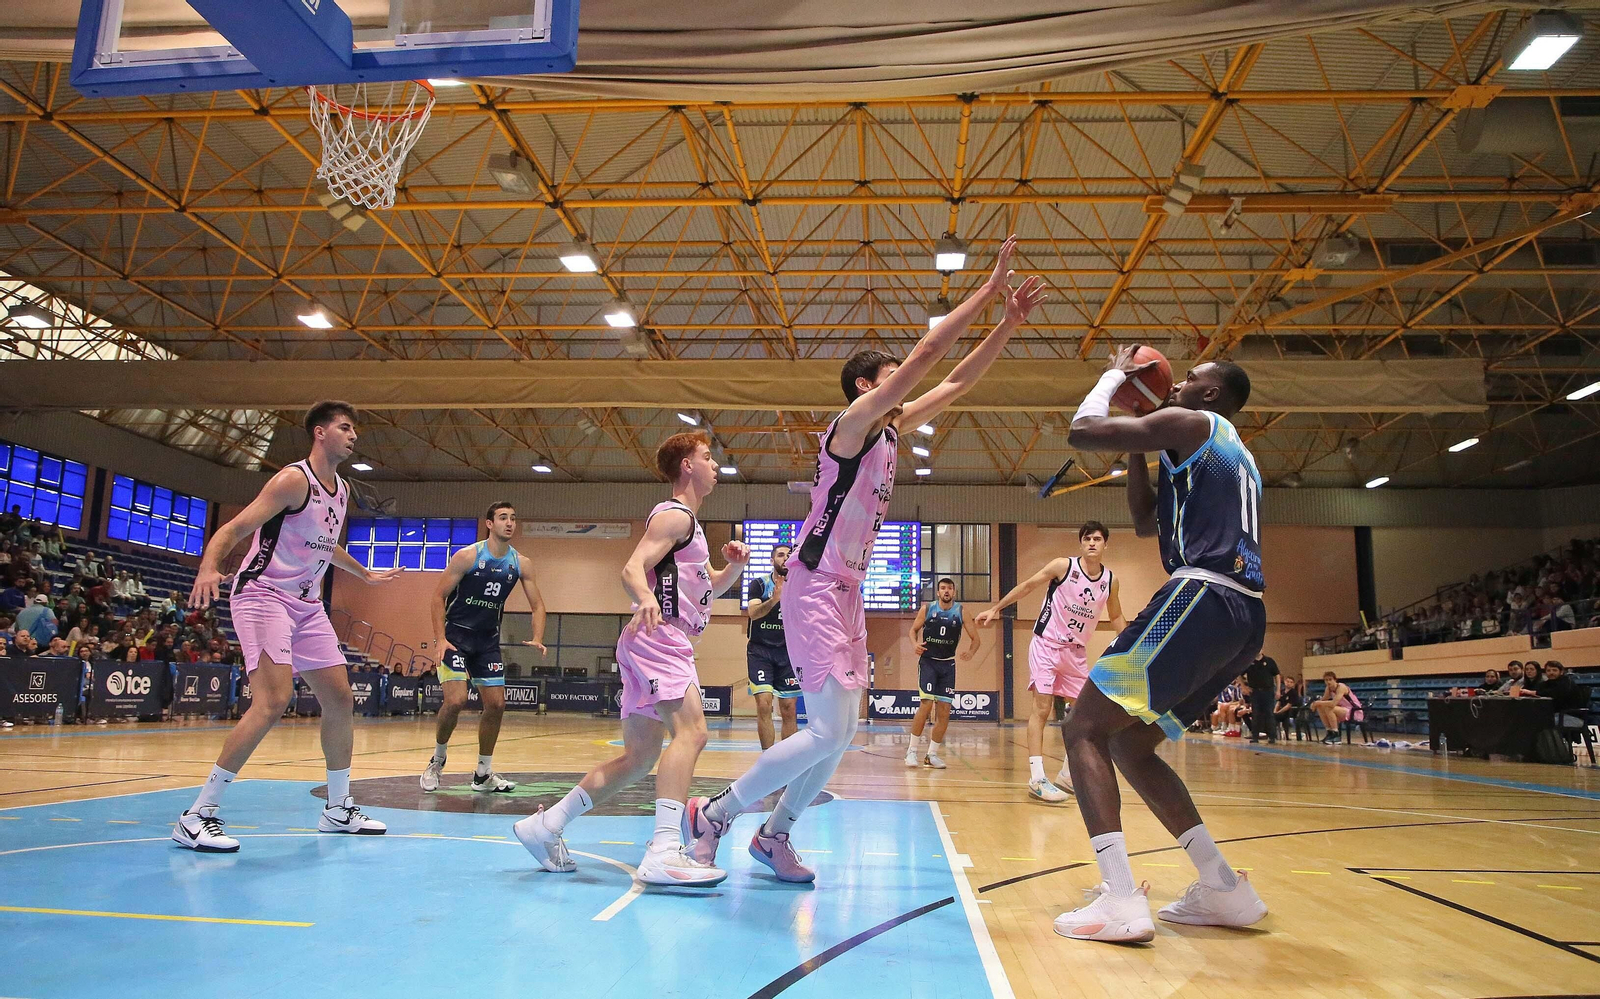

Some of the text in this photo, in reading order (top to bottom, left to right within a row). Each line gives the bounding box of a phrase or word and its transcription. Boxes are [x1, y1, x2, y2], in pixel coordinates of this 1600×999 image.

[1238, 462, 1258, 545] 11
[315, 559, 325, 575] 7
[484, 582, 501, 597] 29
[662, 573, 673, 616] EDYTEL
[700, 590, 712, 606] 8
[940, 626, 946, 636] 0
[1067, 618, 1085, 633] 24
[126, 669, 151, 695] ice
[757, 670, 766, 682] 2
[927, 683, 932, 692] 0
[13, 693, 58, 703] ASESORES
